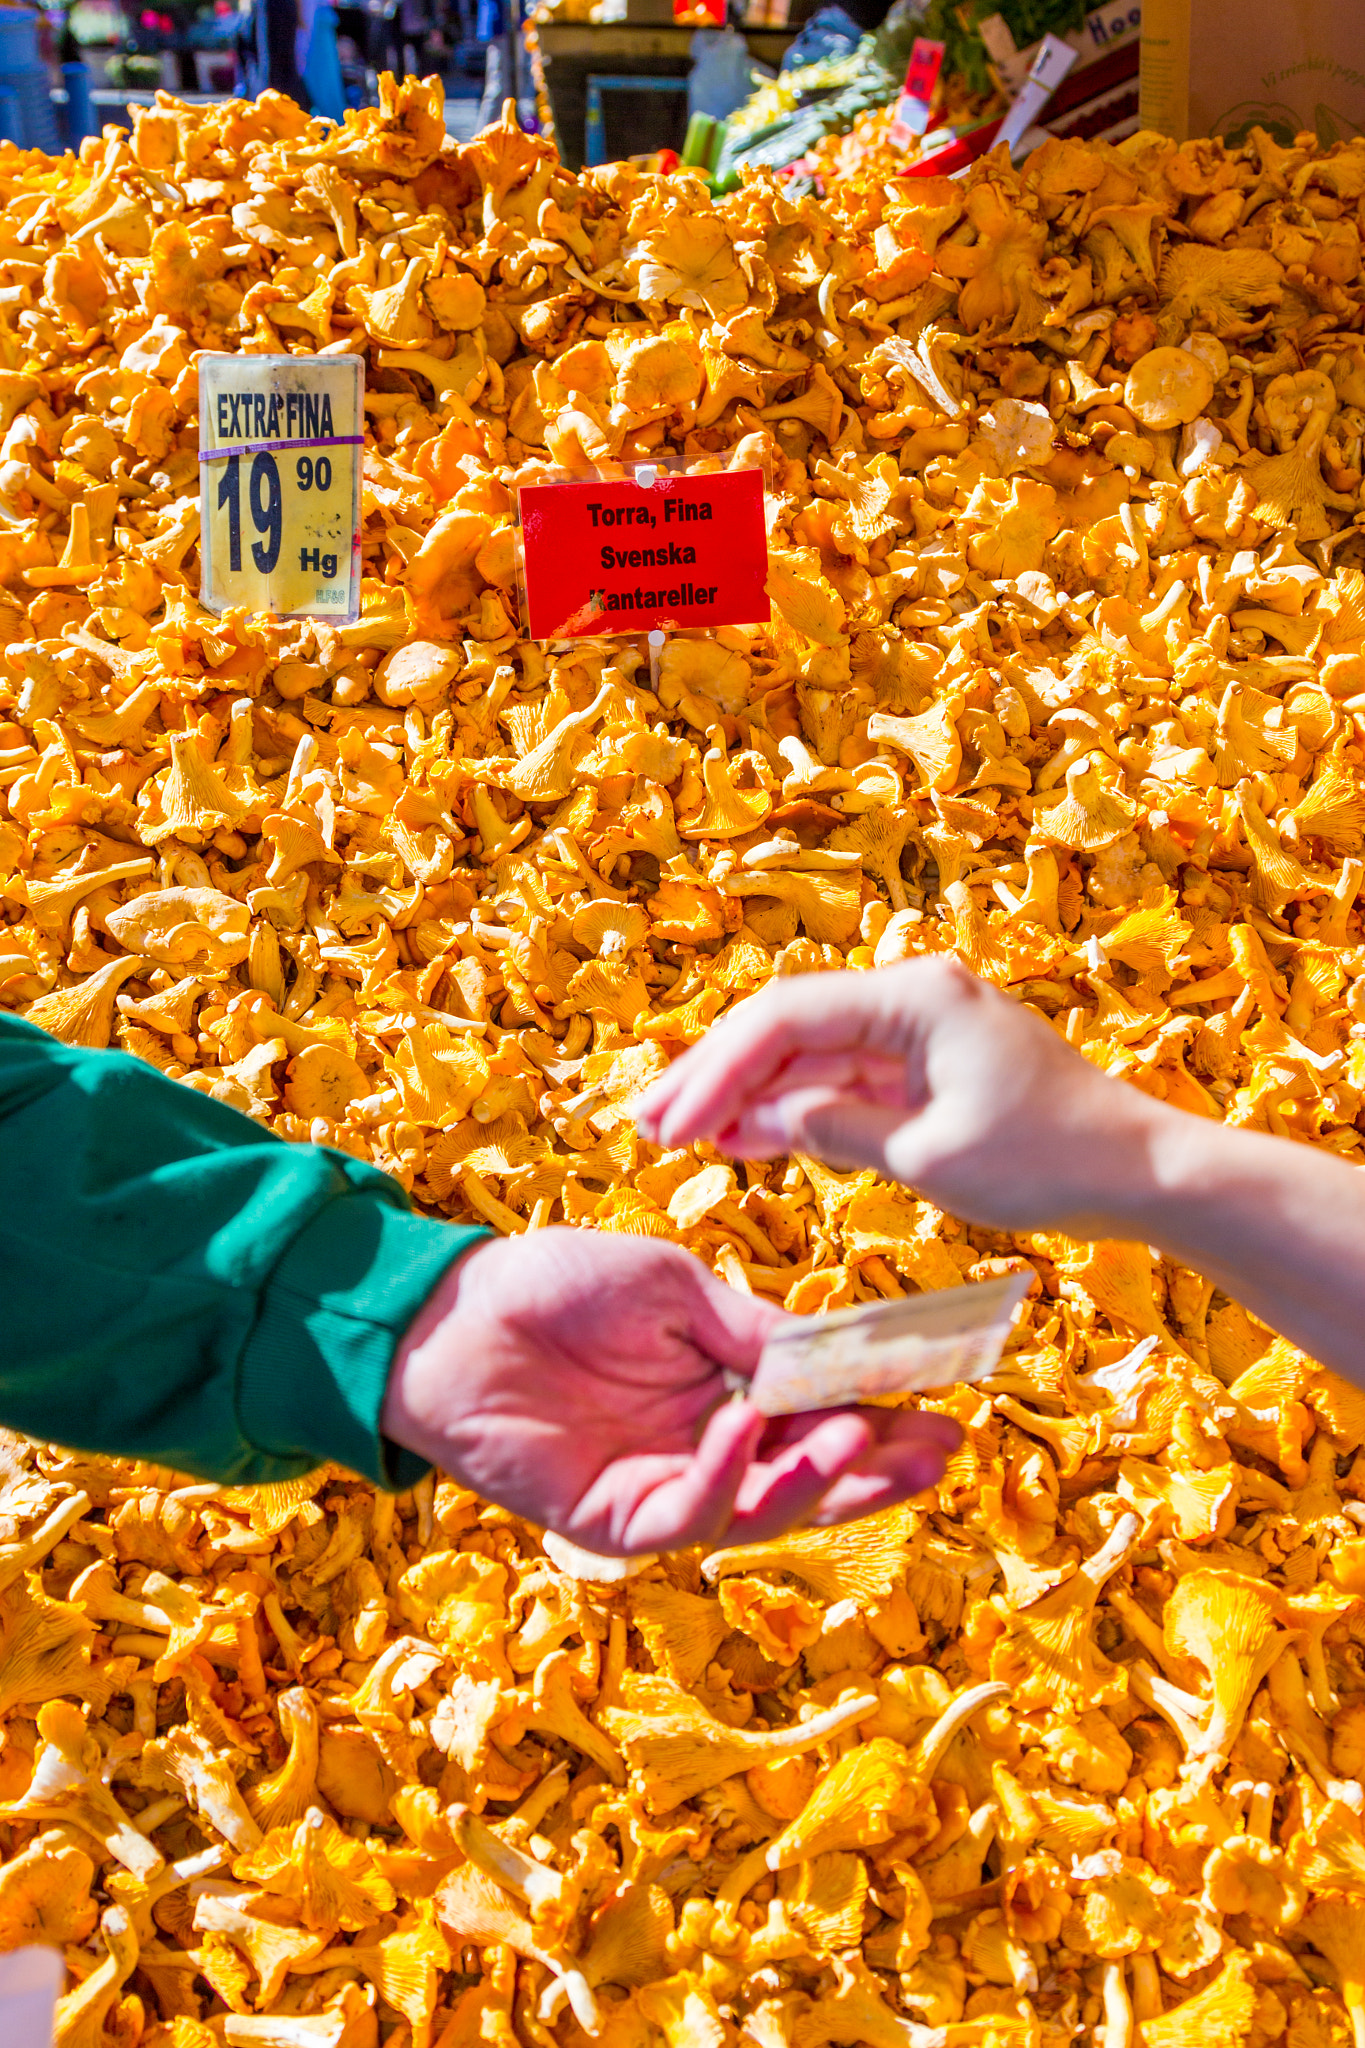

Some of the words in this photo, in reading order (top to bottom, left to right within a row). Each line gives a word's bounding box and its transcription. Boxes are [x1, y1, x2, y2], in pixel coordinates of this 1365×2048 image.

[217, 393, 280, 438] EXTRA
[287, 393, 335, 438] FINA
[217, 450, 282, 575] 19
[296, 456, 332, 492] 90
[587, 502, 657, 529] Torra,
[664, 498, 713, 523] Fina
[300, 547, 338, 579] Hg
[600, 542, 696, 569] Svenska
[589, 582, 718, 612] Kantareller
